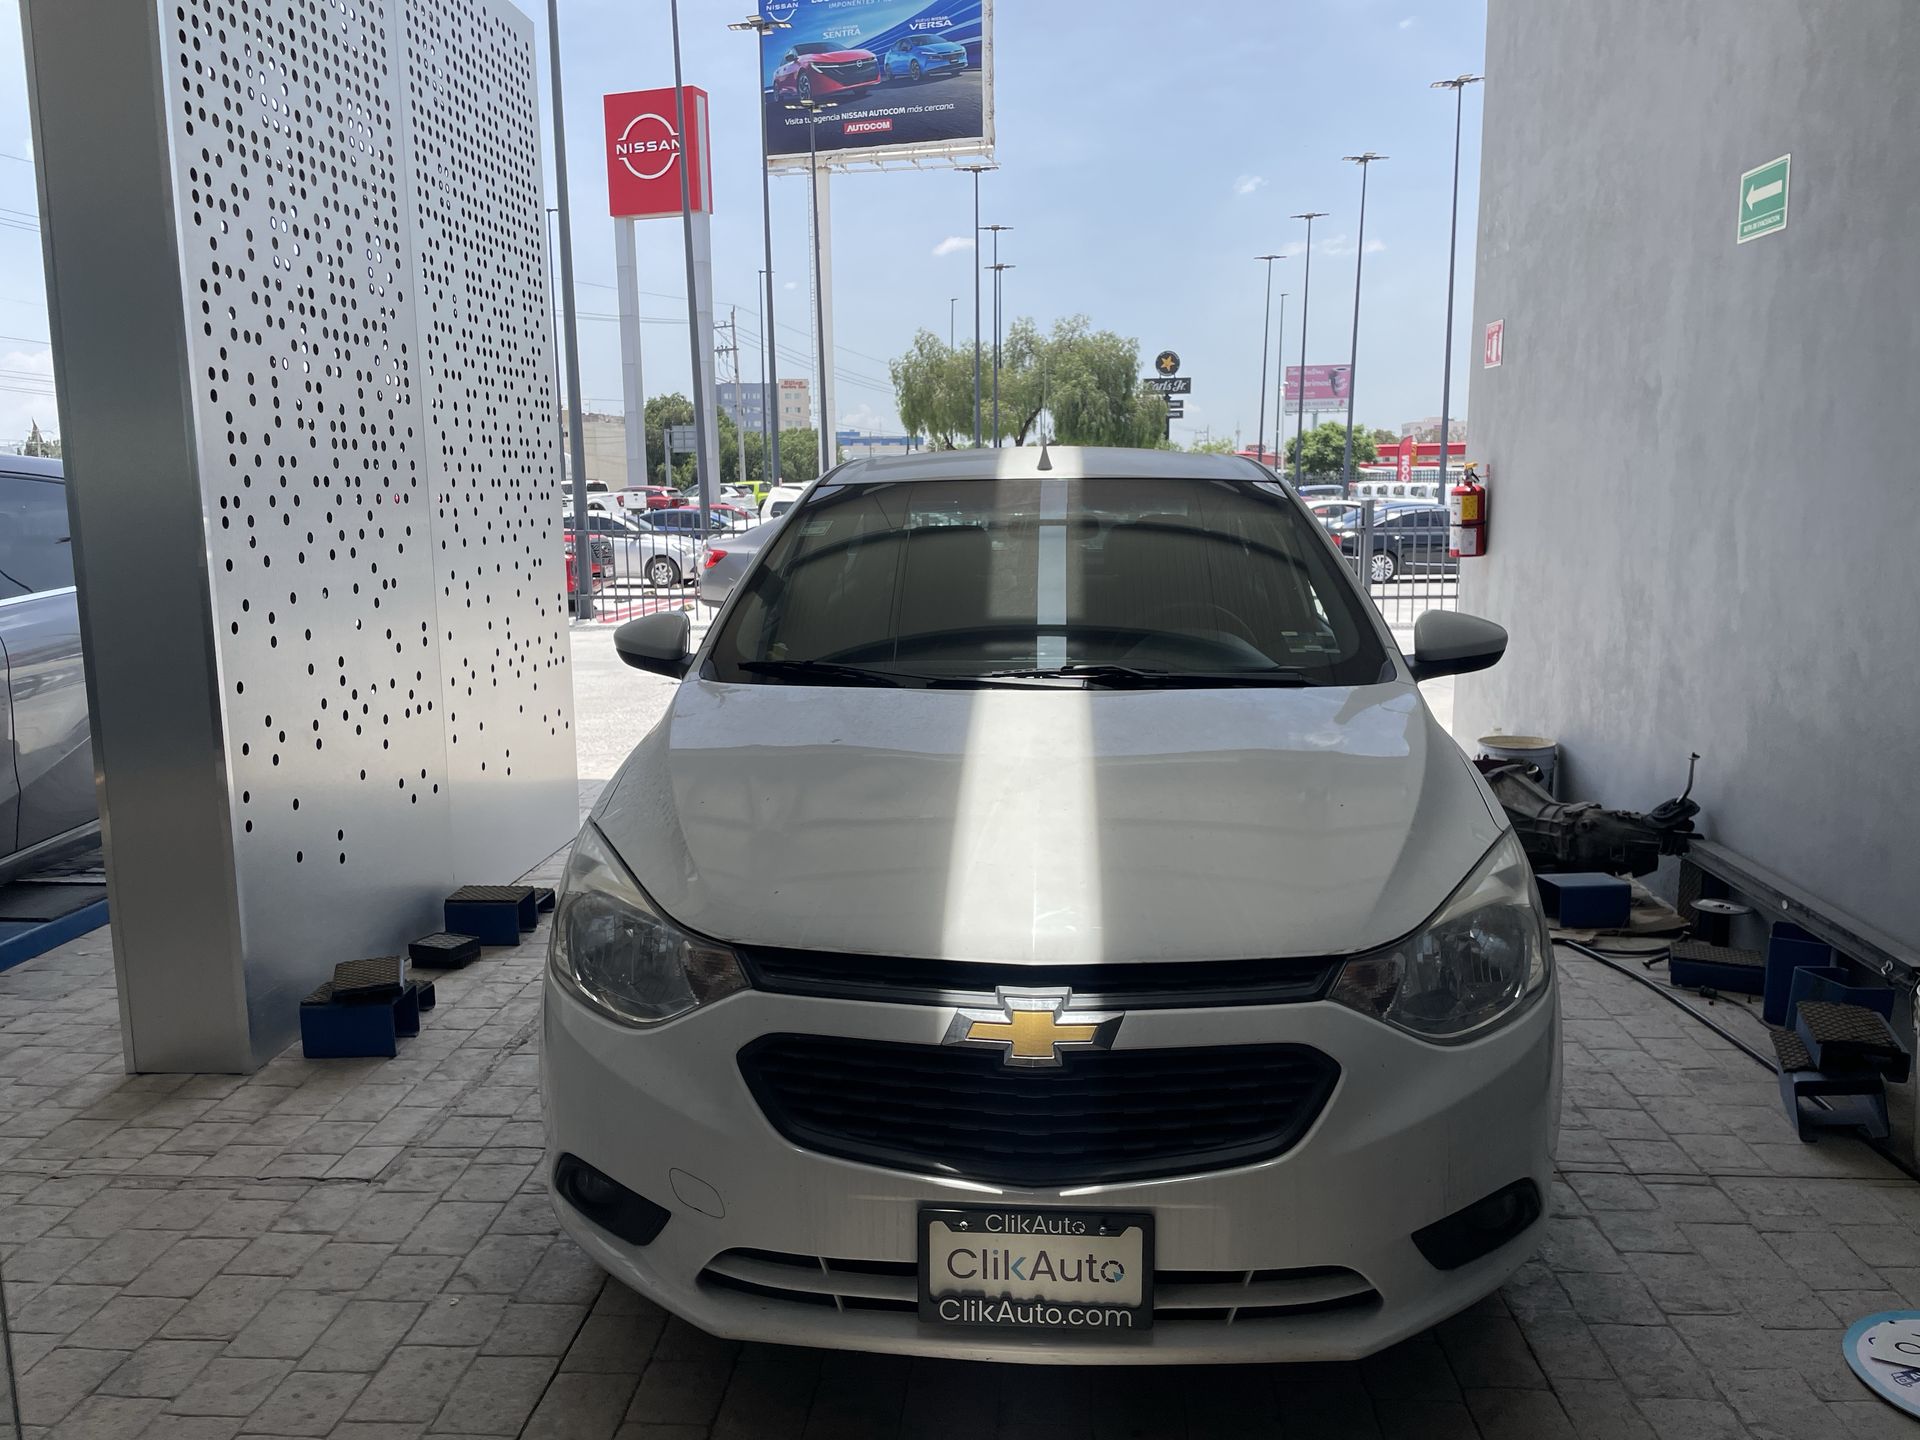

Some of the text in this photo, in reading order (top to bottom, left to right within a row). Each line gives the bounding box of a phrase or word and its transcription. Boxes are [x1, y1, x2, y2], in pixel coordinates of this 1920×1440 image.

[766, 2, 799, 11] NISSAN
[909, 19, 953, 31] VERSA
[822, 28, 862, 40] SENTRA
[784, 117, 803, 126] Visita
[813, 114, 841, 124] agencia
[841, 110, 868, 120] NISSAN
[869, 106, 906, 117] AUTOCOM
[907, 104, 923, 114] más
[846, 121, 890, 133] AUTOCOM
[616, 139, 680, 155] NISSAN
[985, 1214, 1086, 1235] ClikAuto
[947, 1248, 1125, 1283] ClikAuto
[939, 1299, 1132, 1327] ClikAuto.com
